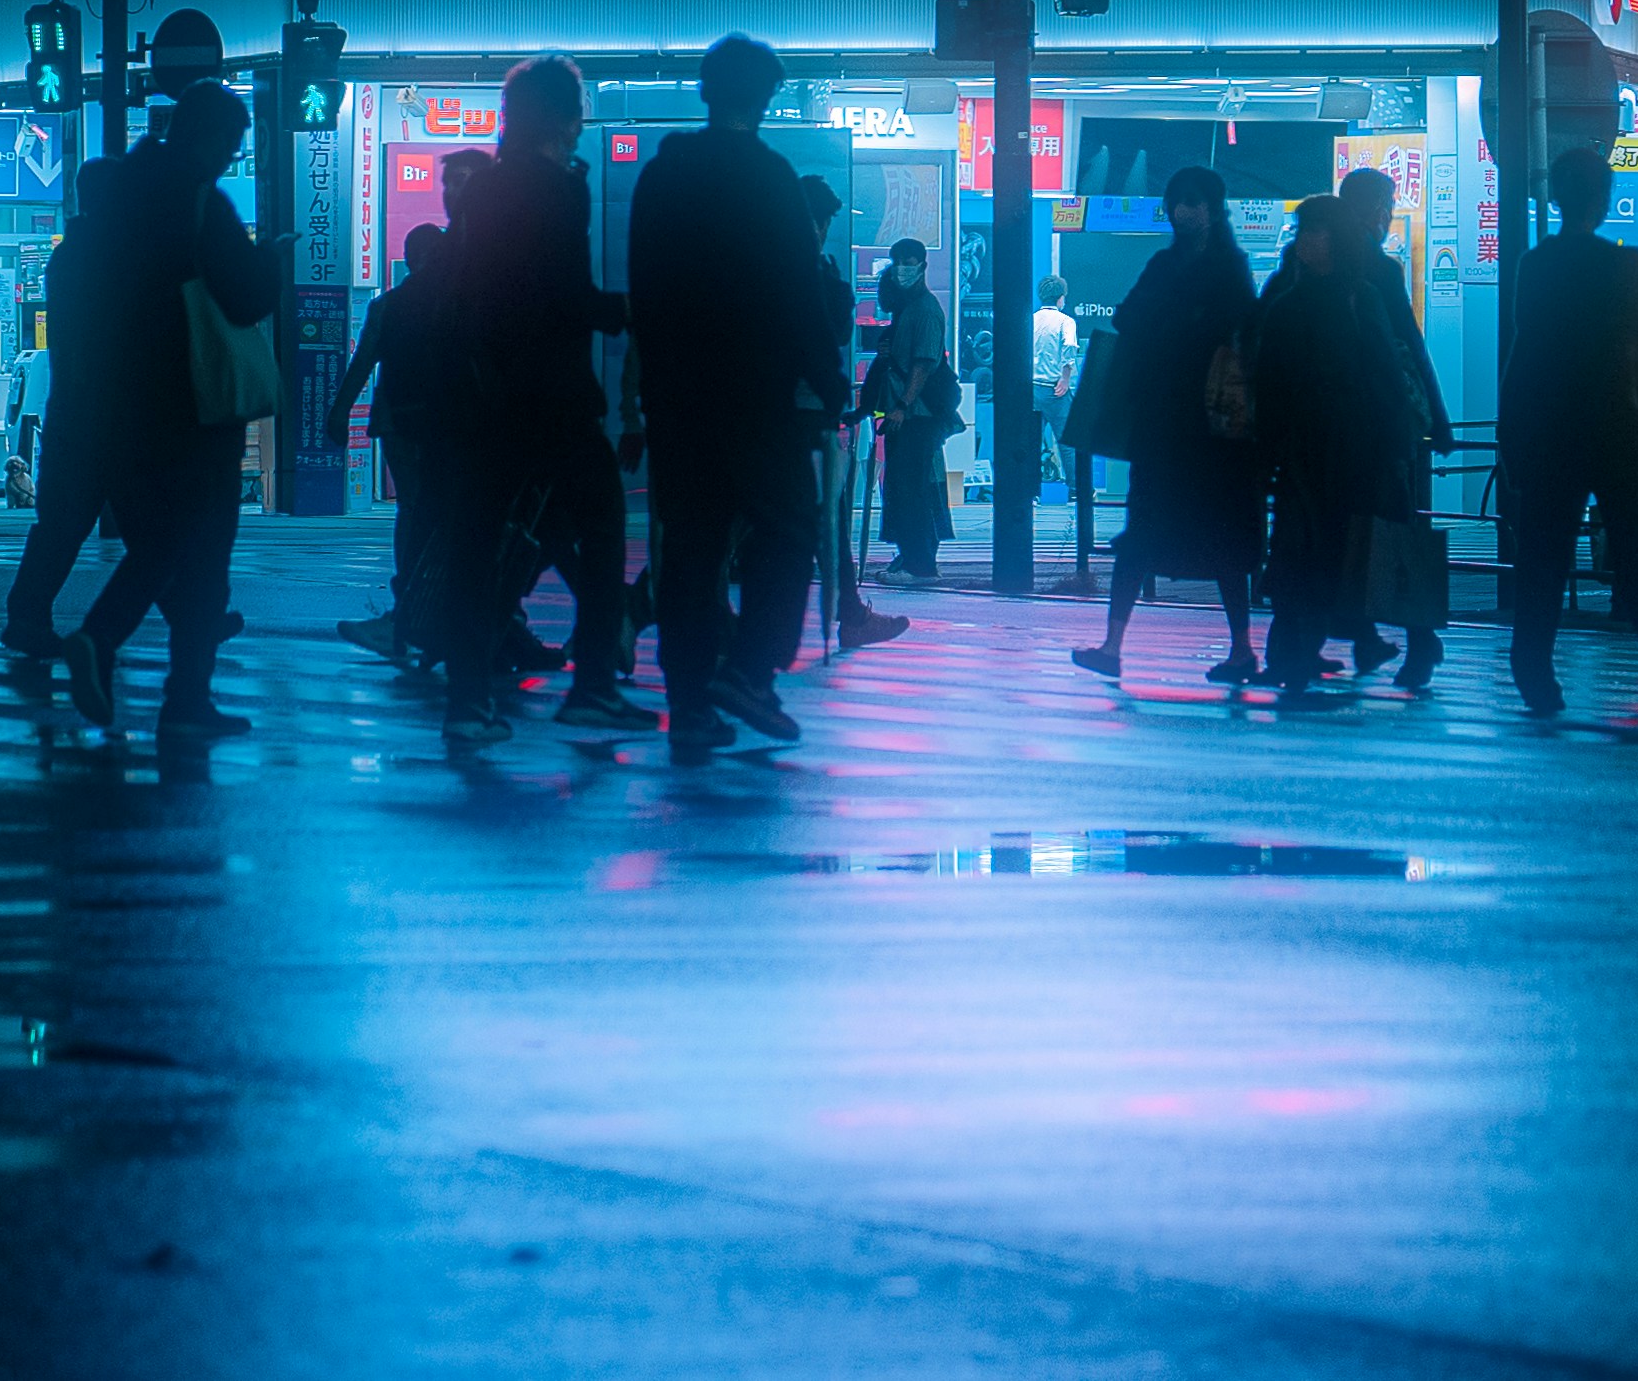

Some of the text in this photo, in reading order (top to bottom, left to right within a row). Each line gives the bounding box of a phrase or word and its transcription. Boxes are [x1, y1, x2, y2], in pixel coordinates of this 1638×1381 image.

[402, 165, 429, 181] B1F
[362, 127, 373, 280] ビックカメラ
[1244, 212, 1269, 223] Tokyo
[310, 263, 336, 282] 3F
[1084, 303, 1117, 317] iPho
